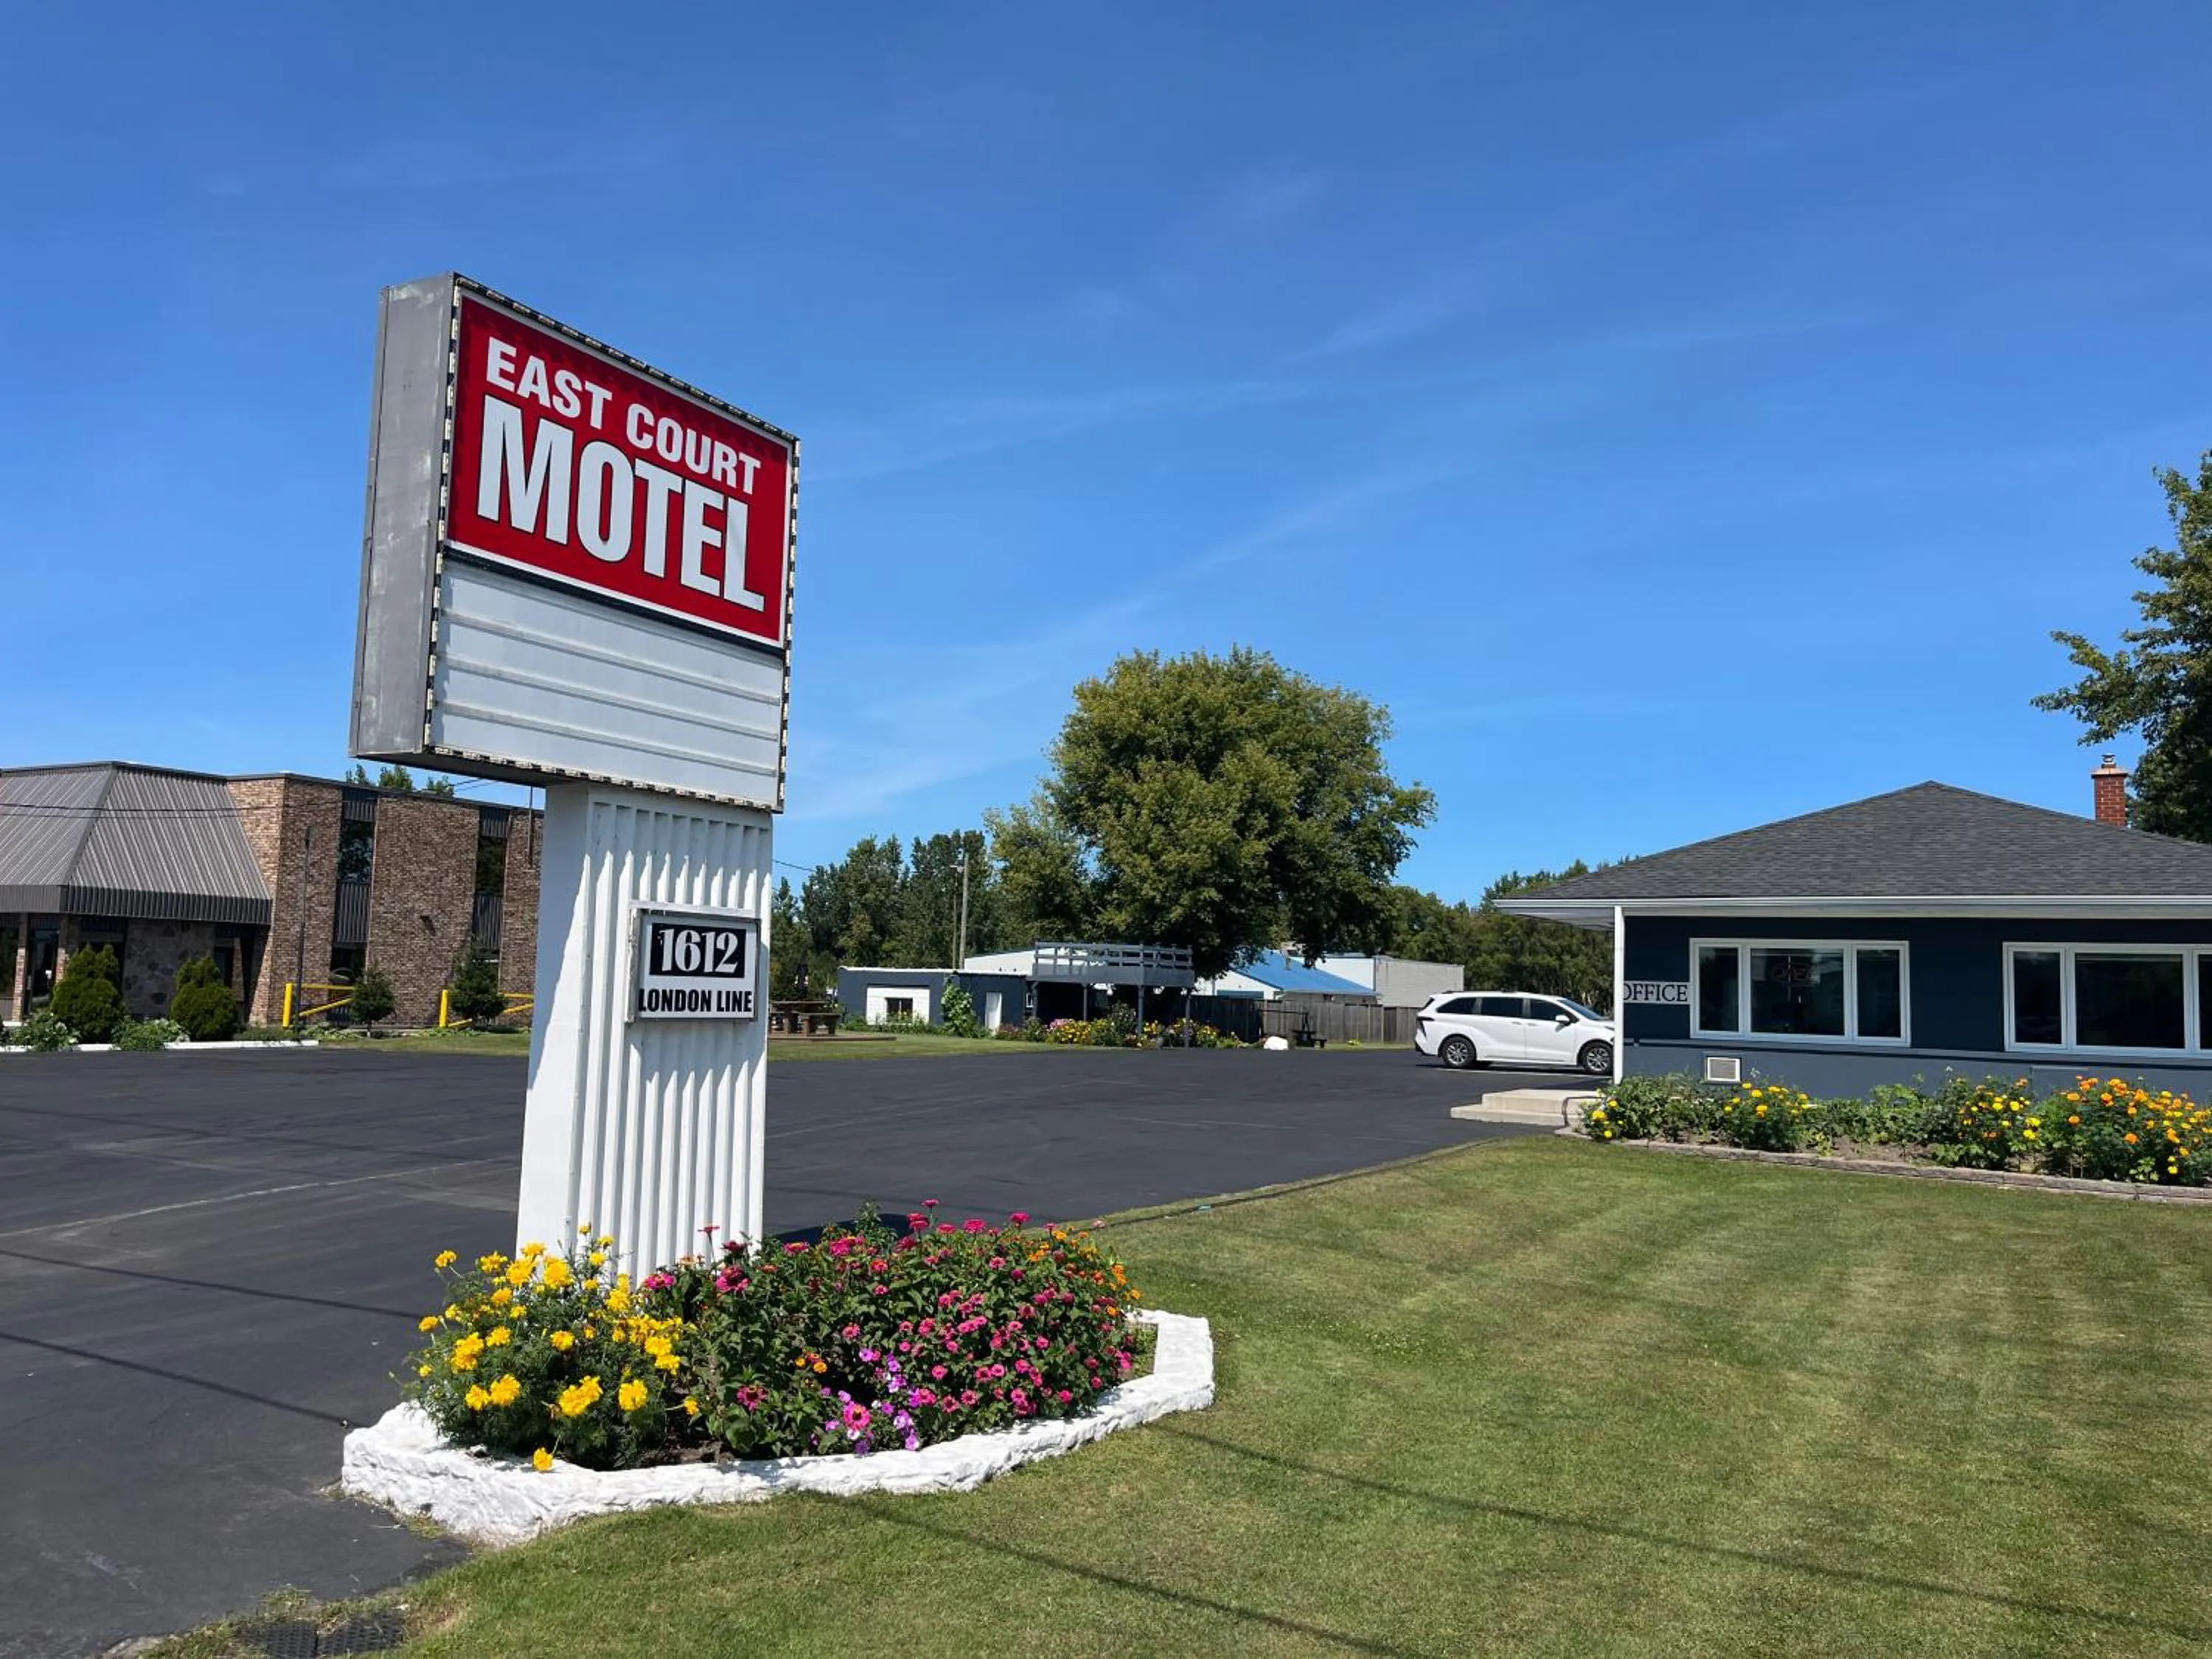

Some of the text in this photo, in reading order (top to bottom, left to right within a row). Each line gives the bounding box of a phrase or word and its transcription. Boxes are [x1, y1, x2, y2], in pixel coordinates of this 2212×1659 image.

[486, 336, 761, 495] EAST COURT
[477, 394, 765, 612] MOTEL
[639, 988, 752, 1012] LONDON LINE
[658, 928, 738, 973] 1612
